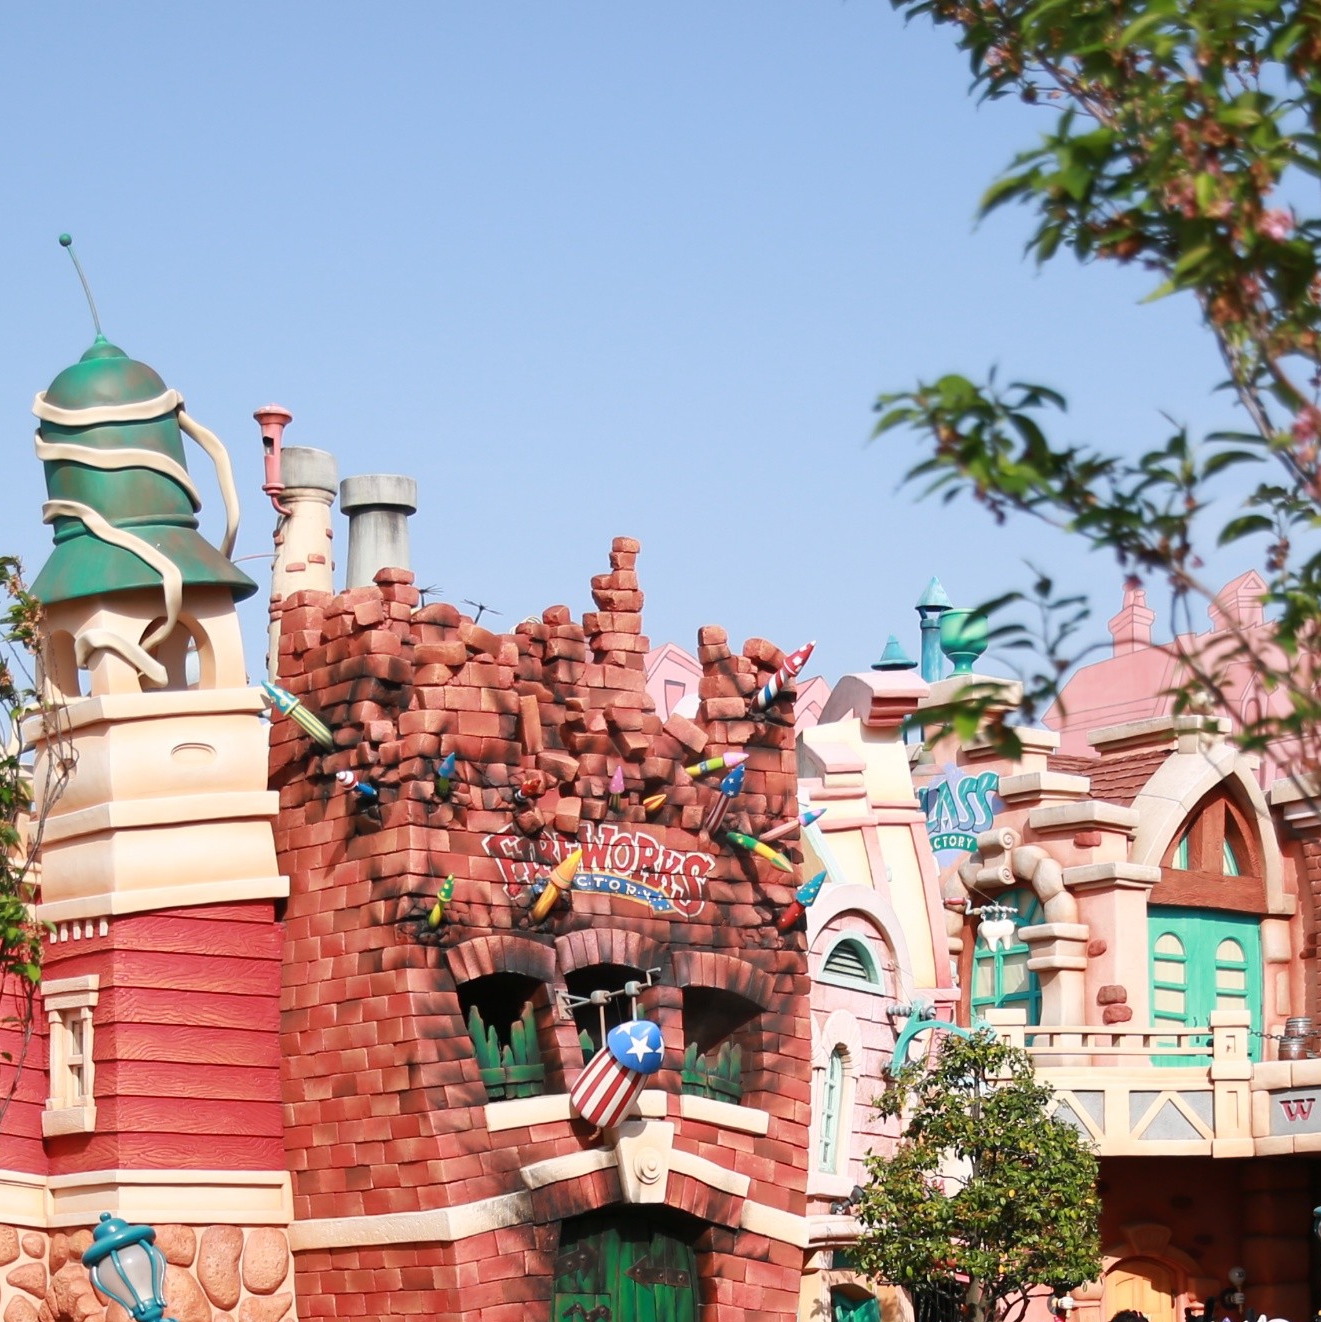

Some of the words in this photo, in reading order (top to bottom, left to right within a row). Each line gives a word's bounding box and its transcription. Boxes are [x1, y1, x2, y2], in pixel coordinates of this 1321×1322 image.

[918, 770, 999, 834] LASS
[933, 835, 973, 851] CTORY
[575, 876, 656, 904] CTORY
